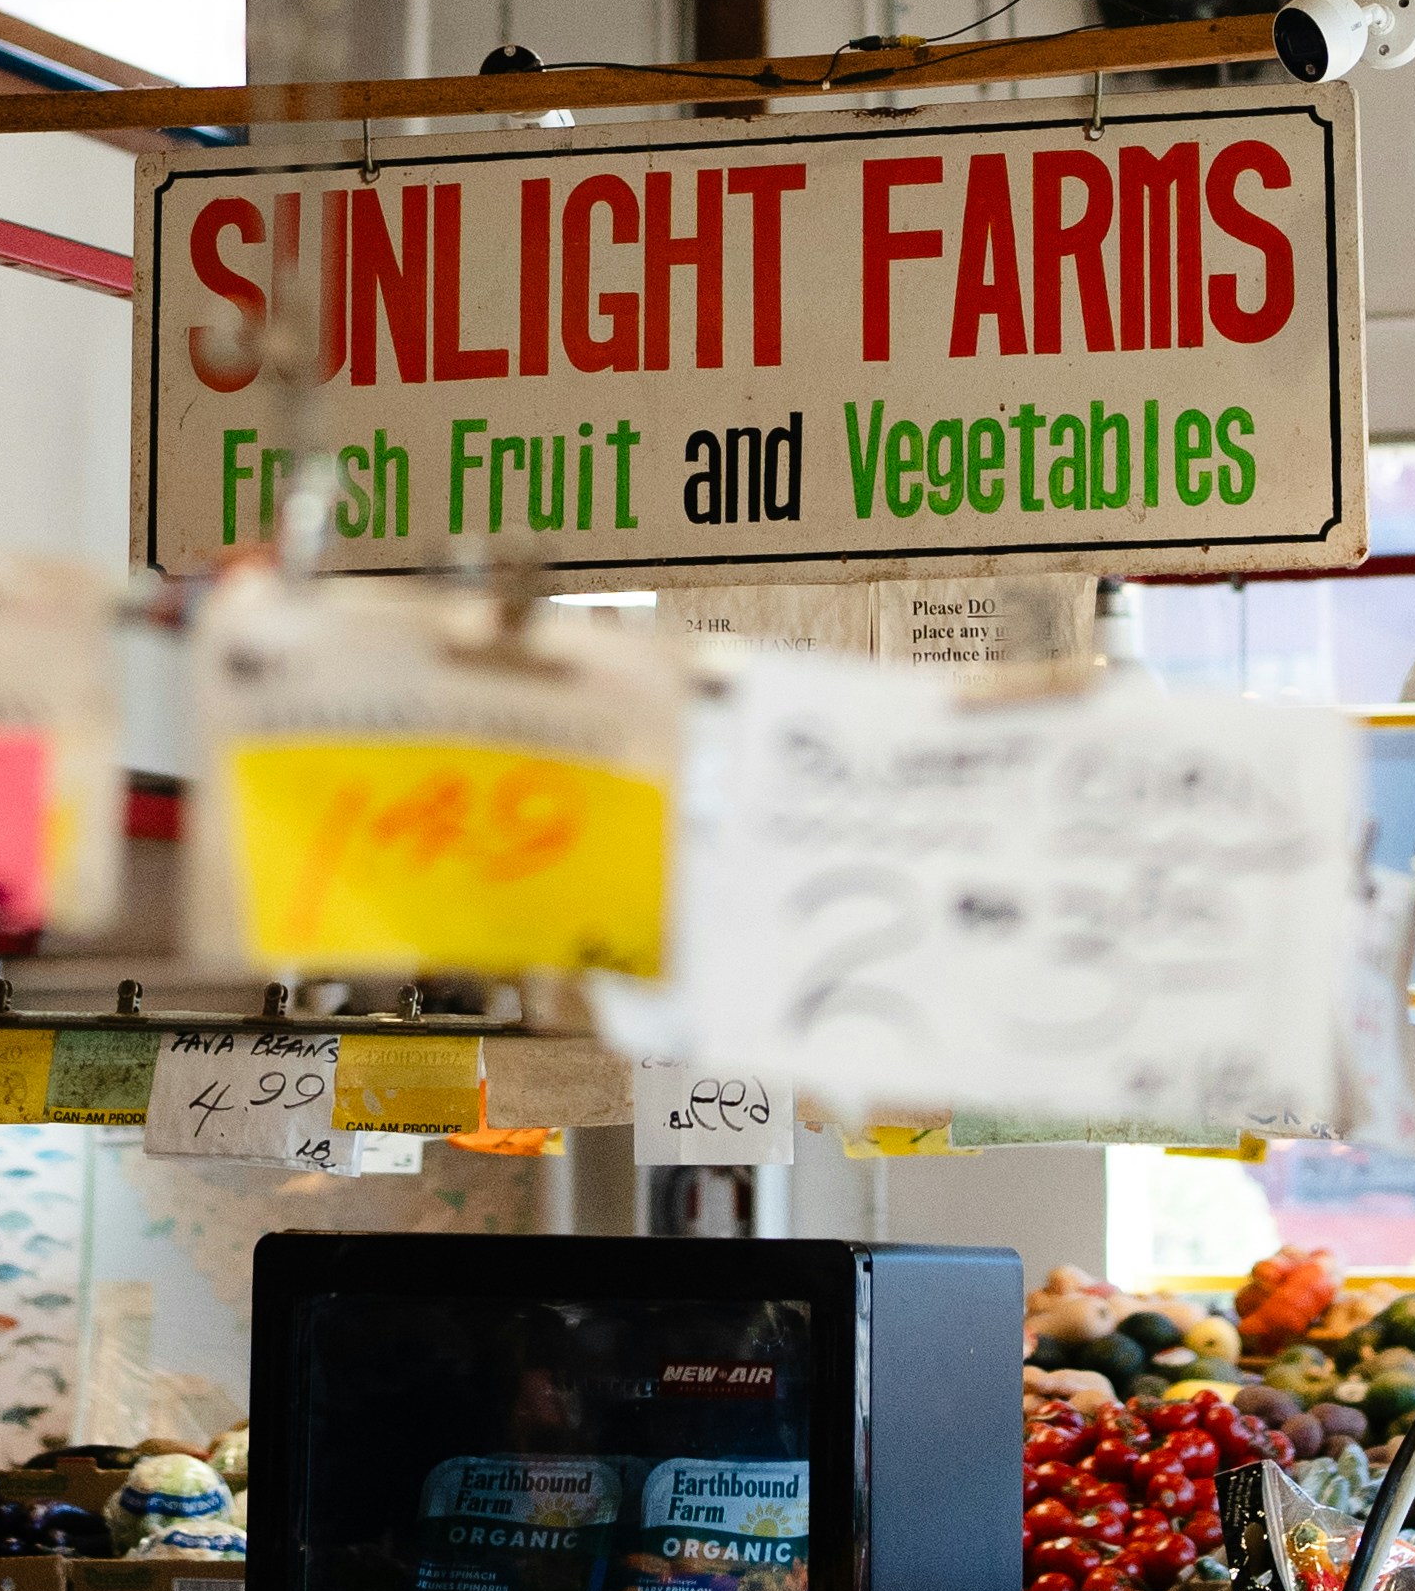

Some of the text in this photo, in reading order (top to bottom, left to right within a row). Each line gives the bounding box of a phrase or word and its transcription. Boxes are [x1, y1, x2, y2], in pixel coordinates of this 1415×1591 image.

[188, 139, 1295, 393] SUNLIGHT FARMS
[222, 400, 1257, 545] Frsh Fruit and Vegetables
[912, 599, 997, 616] Please DO
[708, 619, 736, 633] HR.
[912, 624, 955, 643] place
[960, 626, 990, 642] any
[912, 647, 980, 666] produce
[171, 1032, 339, 1063] FAVA BEANS
[53, 1110, 105, 1124] CAN-AM
[189, 1071, 326, 1138] 4.99
[346, 1121, 463, 1134] CAN-AM PRODUCE
[296, 1138, 331, 1162] LB
[461, 1465, 592, 1494] Earthbound
[672, 1469, 800, 1499] Earthbound
[455, 1490, 514, 1516] Farm
[667, 1497, 726, 1524] Farm
[449, 1526, 580, 1549] ORGANIC
[662, 1537, 793, 1564] ORGANIC
[449, 1569, 498, 1582] SPINACH
